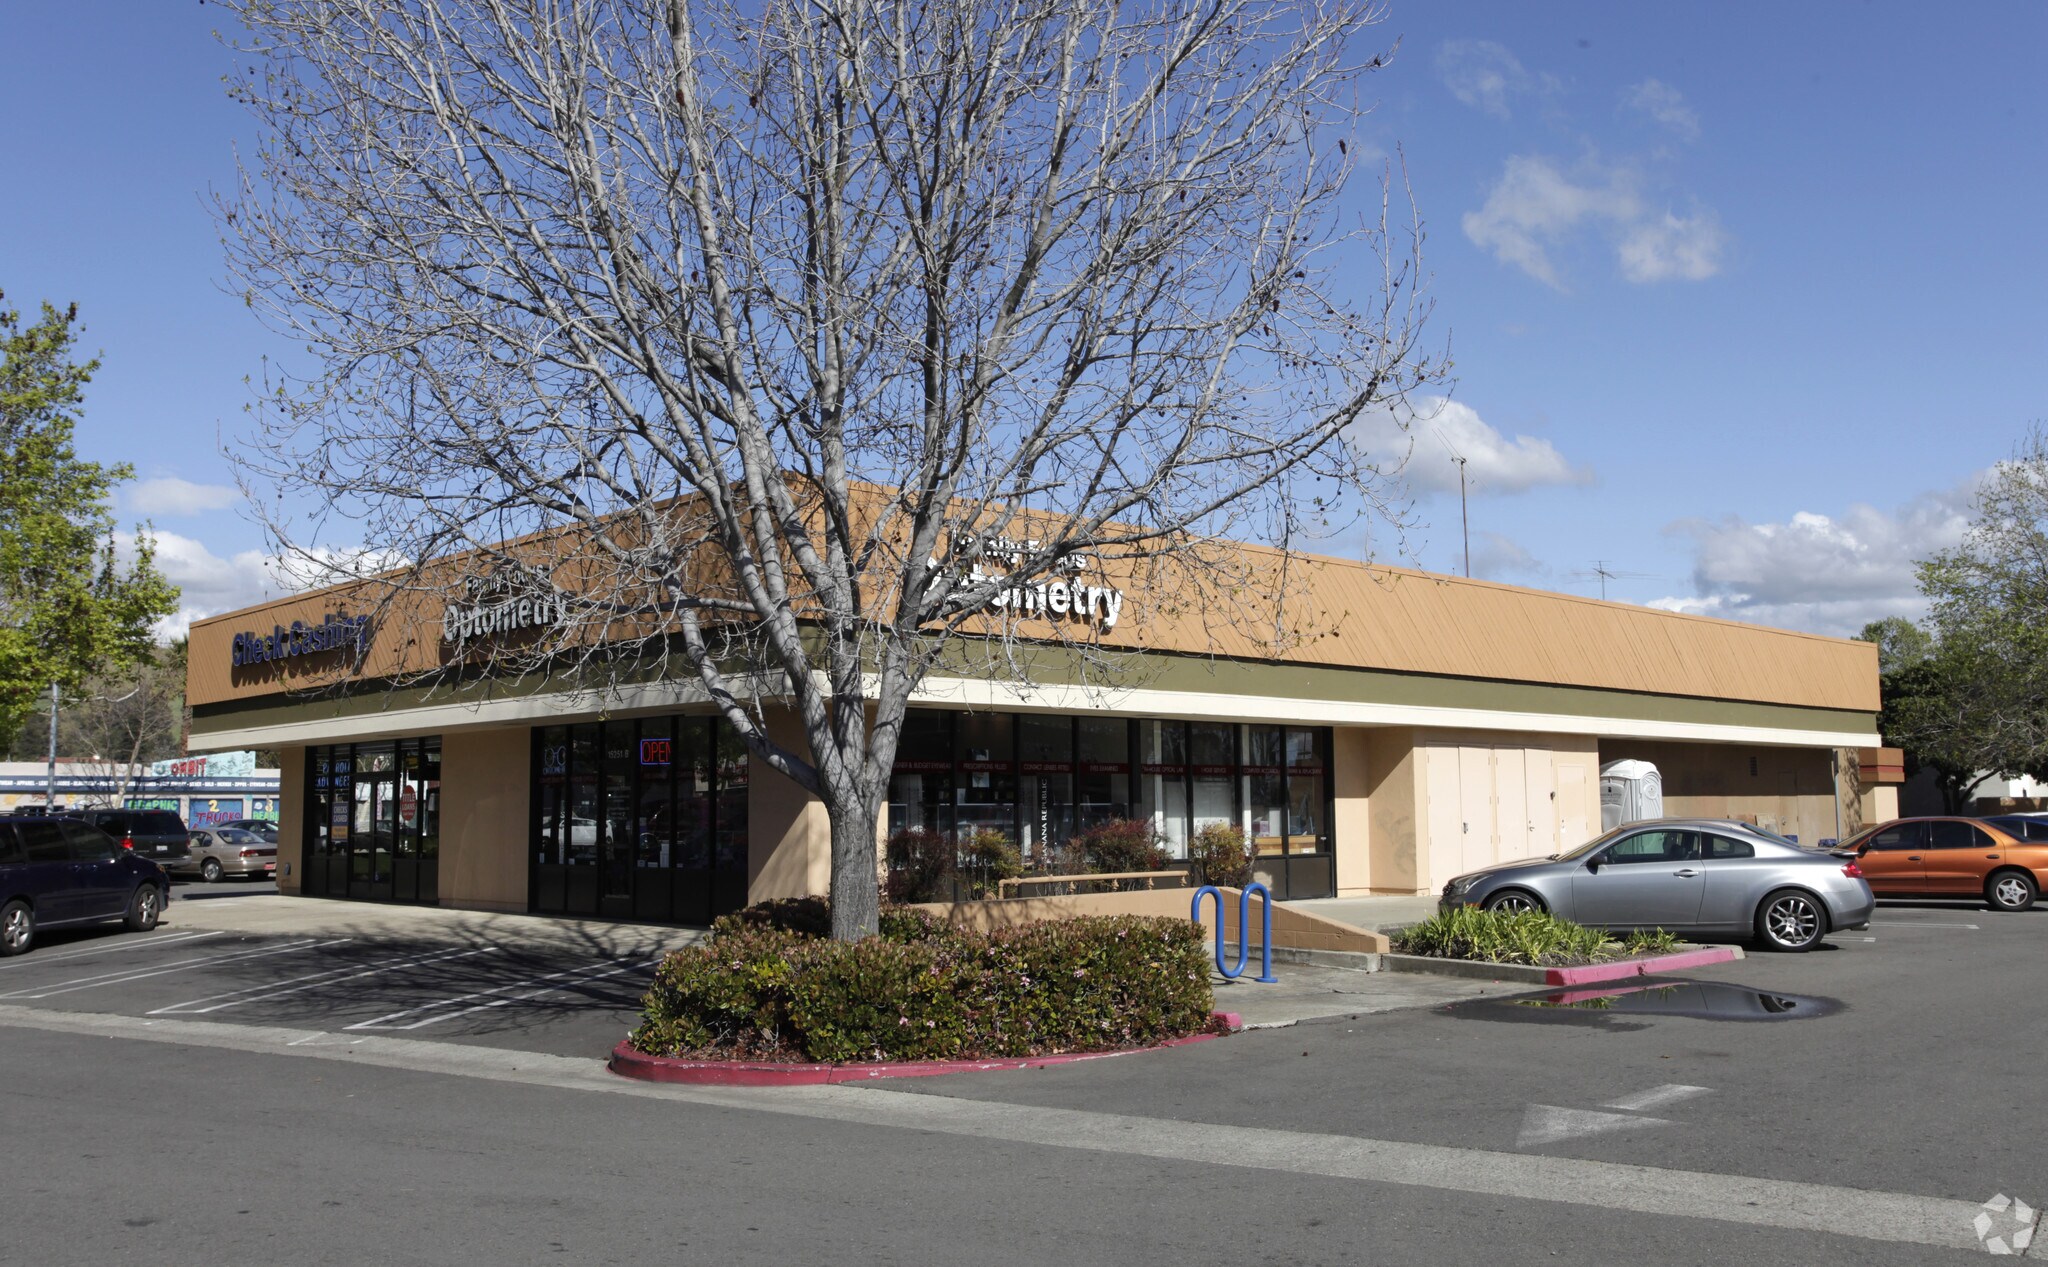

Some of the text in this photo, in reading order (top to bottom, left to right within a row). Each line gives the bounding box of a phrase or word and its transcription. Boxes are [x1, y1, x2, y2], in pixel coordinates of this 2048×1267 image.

[232, 624, 284, 667] Check
[170, 758, 207, 776] ORBIT
[208, 799, 220, 813] 2
